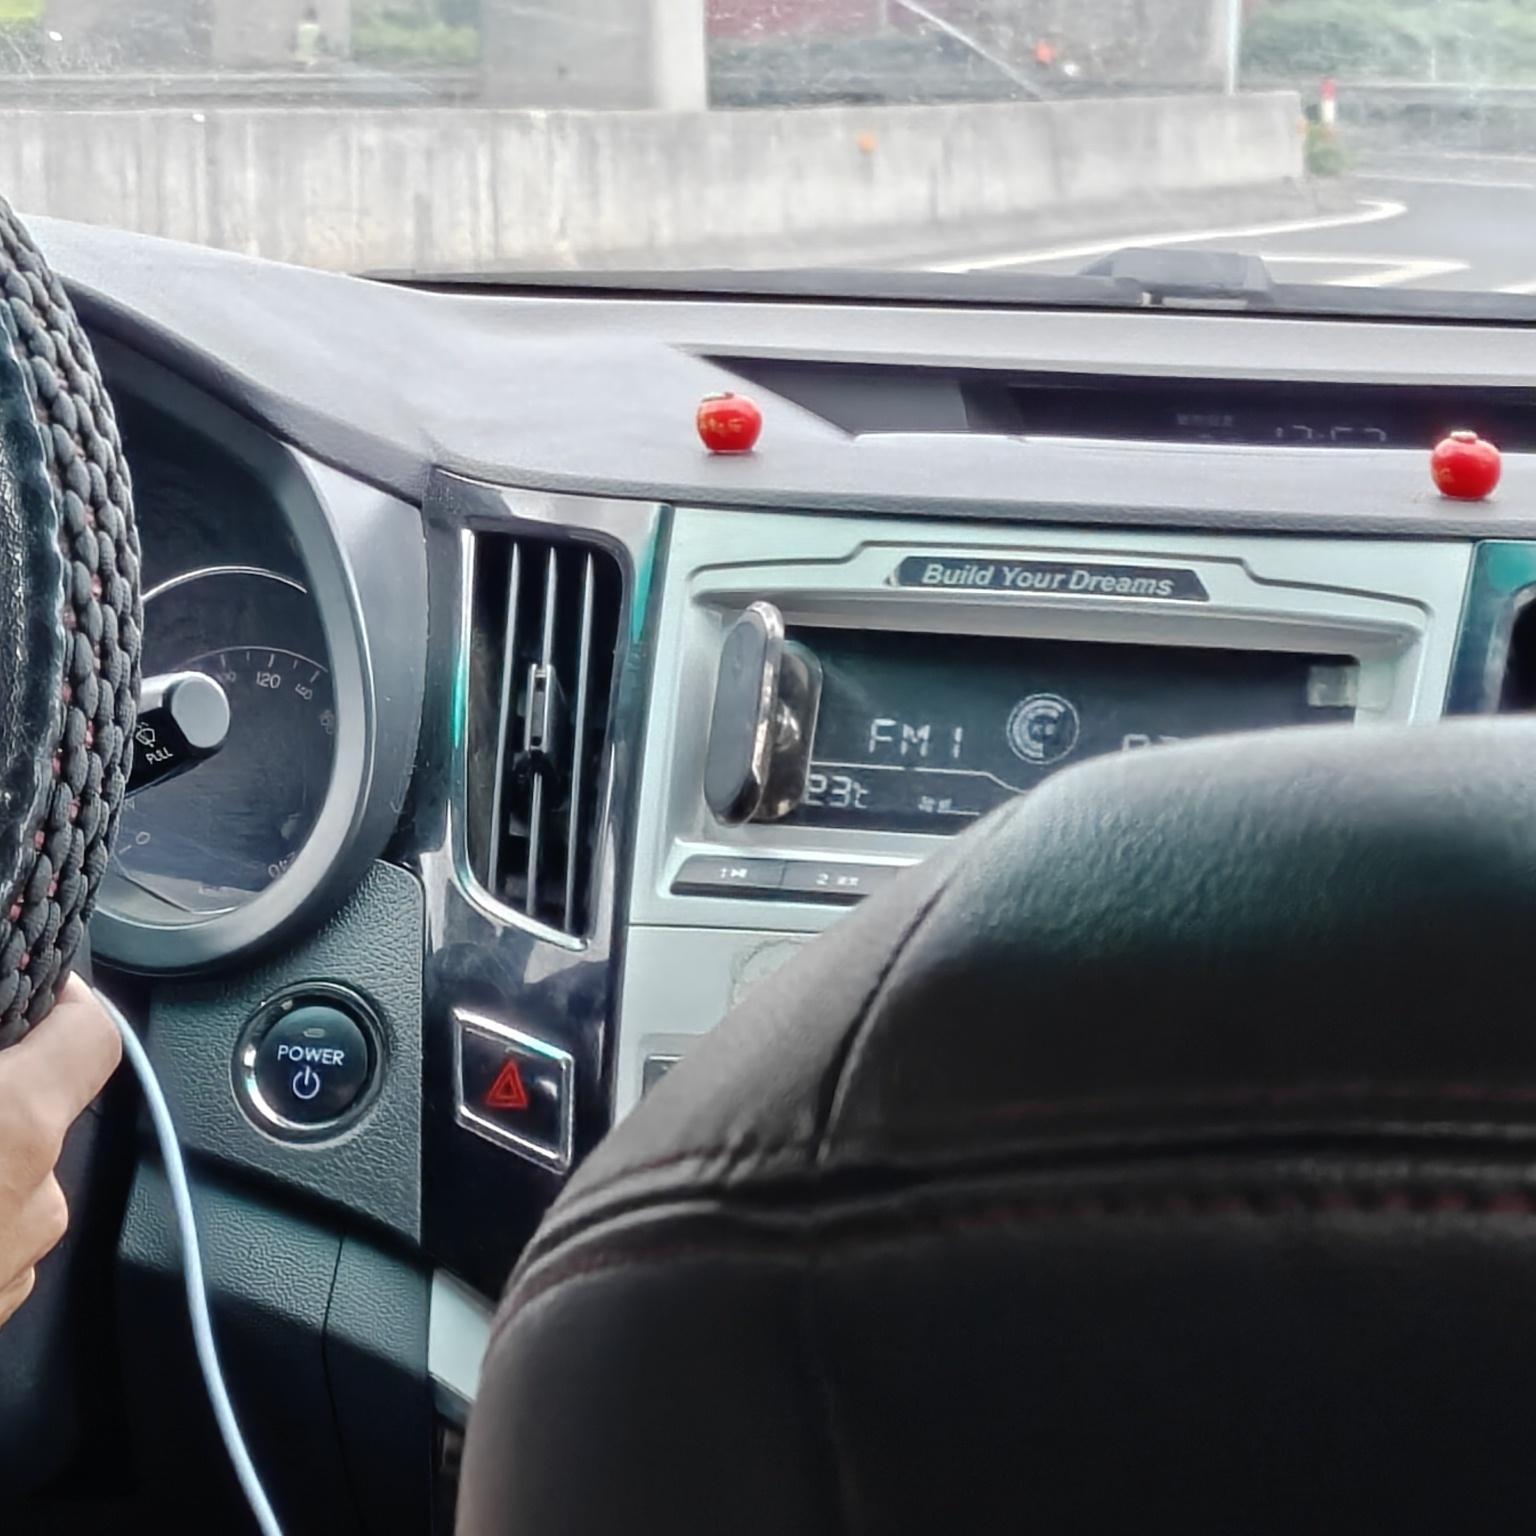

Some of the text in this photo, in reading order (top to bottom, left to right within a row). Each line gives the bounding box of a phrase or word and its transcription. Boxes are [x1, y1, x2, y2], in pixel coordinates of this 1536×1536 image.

[921, 563, 1176, 596] Build Your Dreams
[255, 671, 282, 689] 120
[145, 747, 174, 765] PULL
[277, 1044, 345, 1066] POWER
